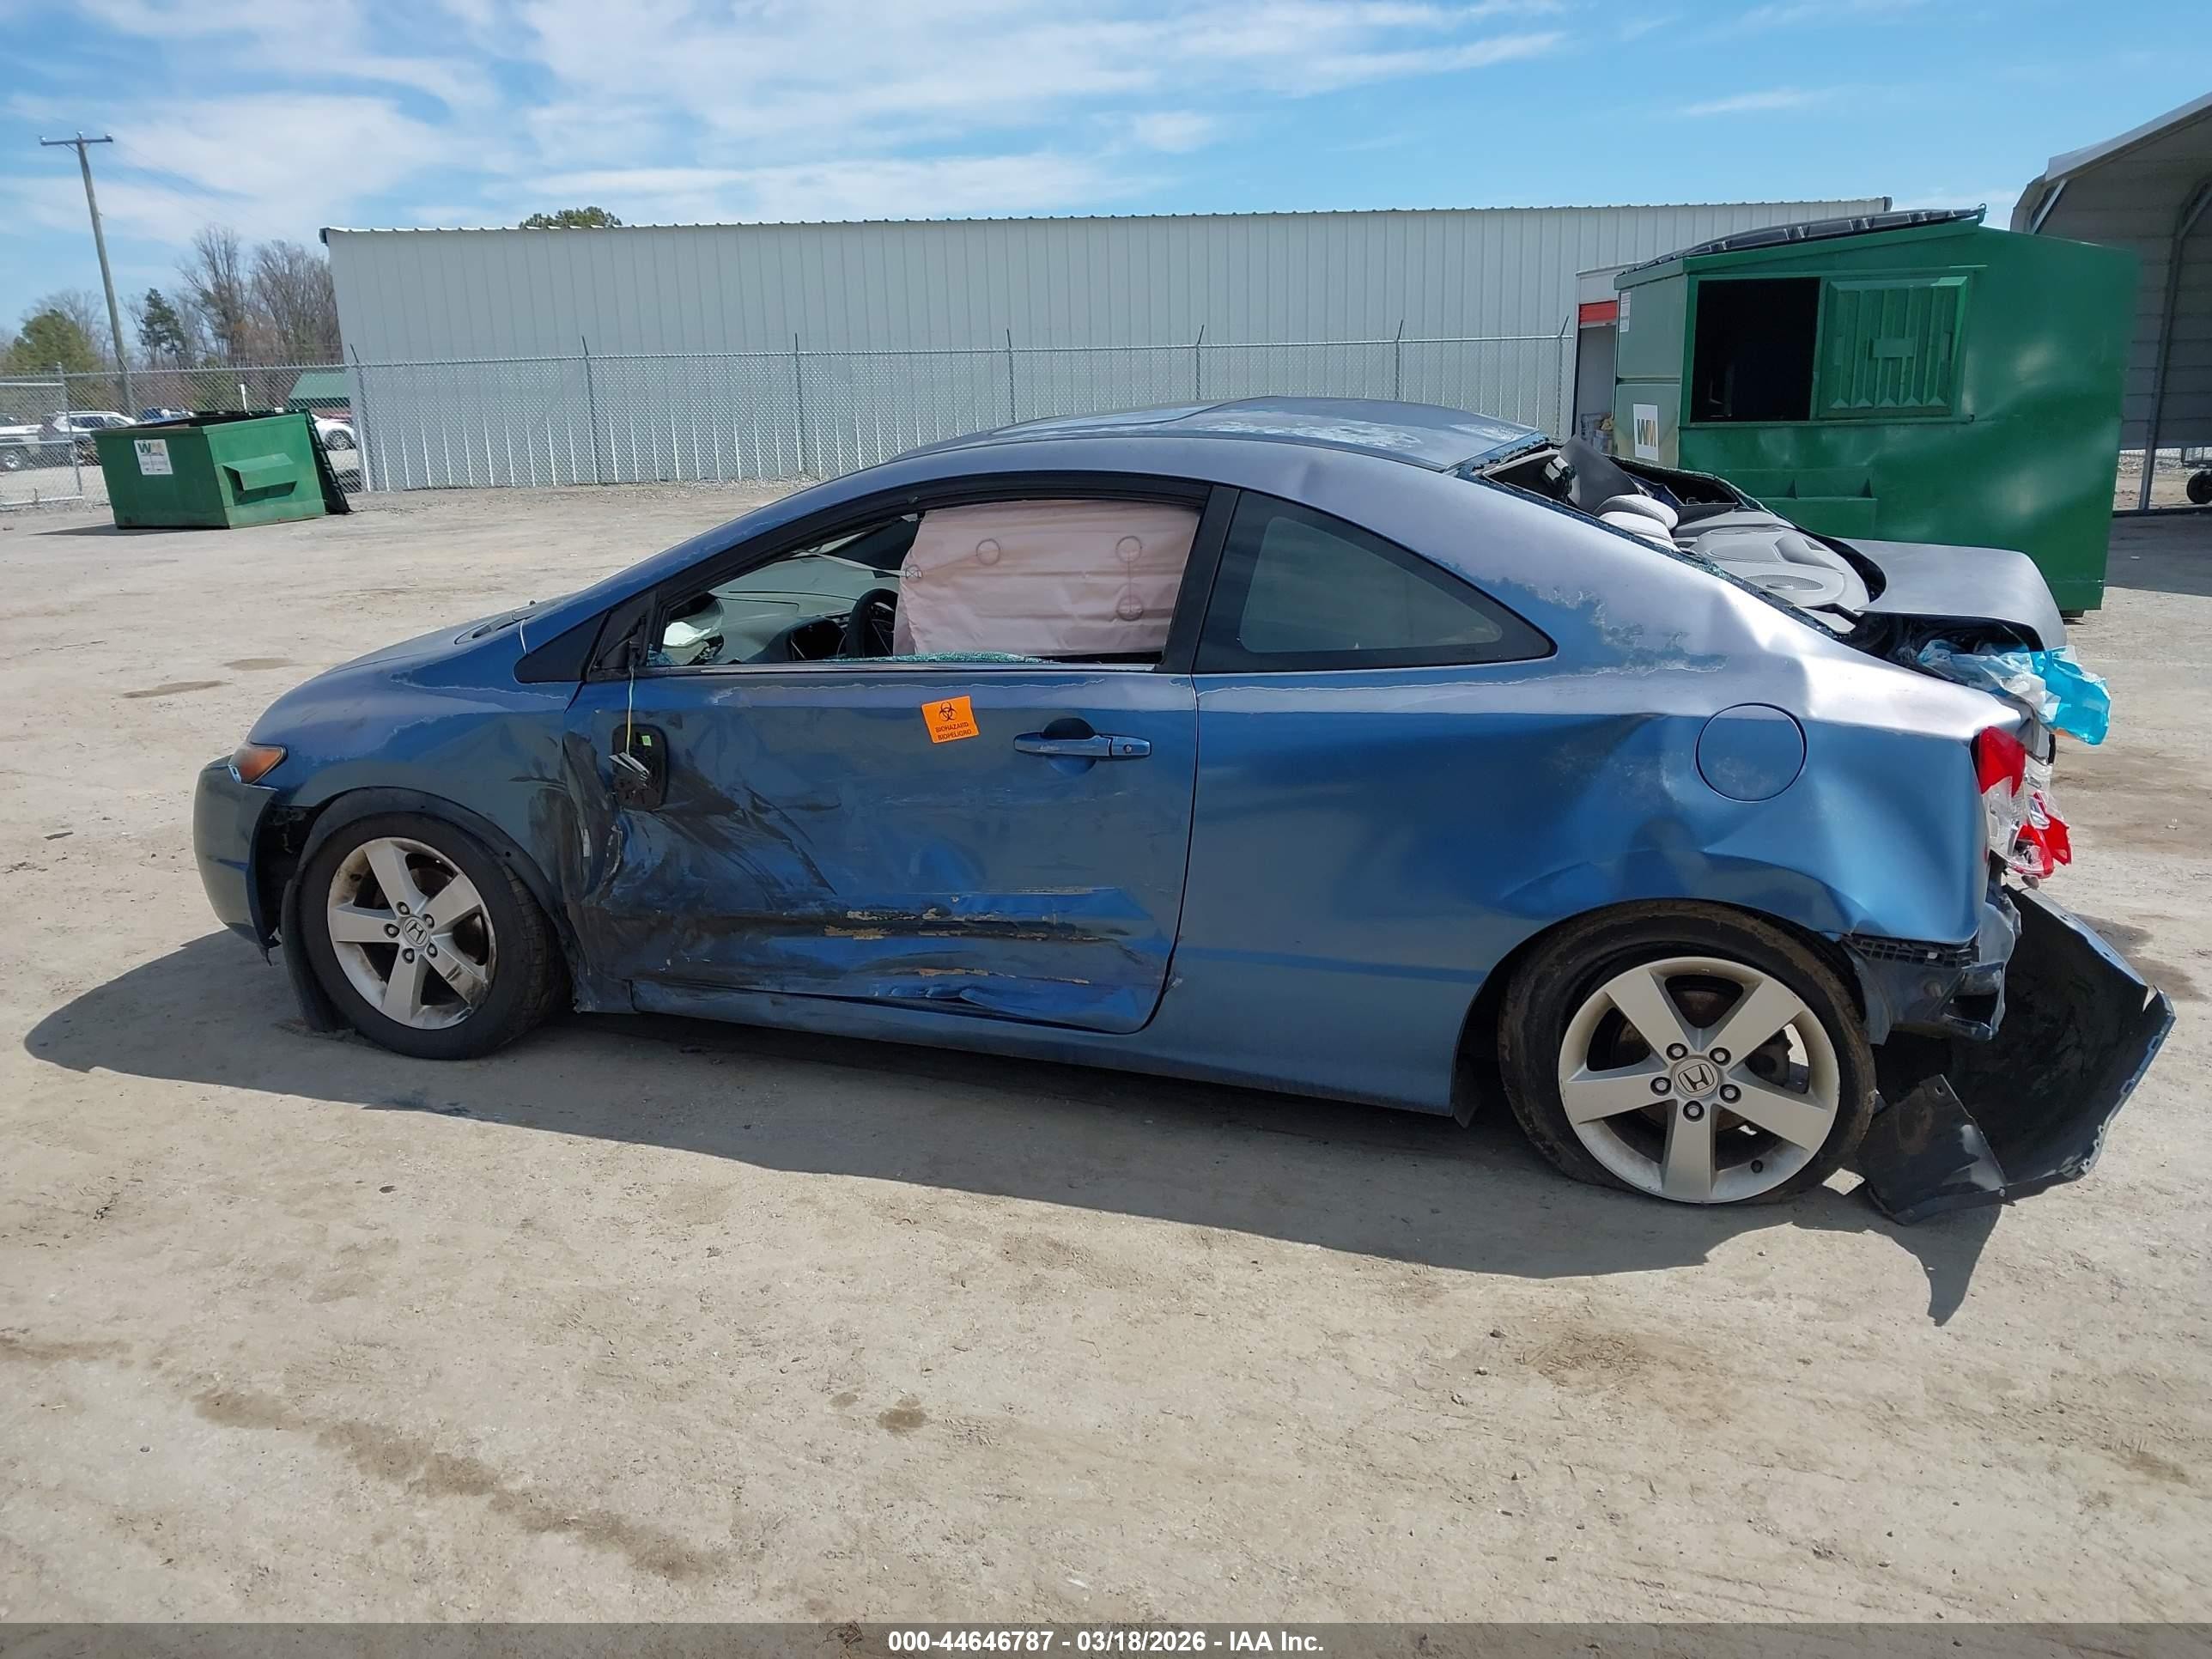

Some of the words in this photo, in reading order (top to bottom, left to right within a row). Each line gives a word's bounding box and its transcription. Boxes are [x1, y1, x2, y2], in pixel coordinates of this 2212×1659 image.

[1637, 418, 1656, 447] WM
[935, 722, 969, 733] BIOHAZARD
[938, 729, 972, 740] BIOPELIGRO
